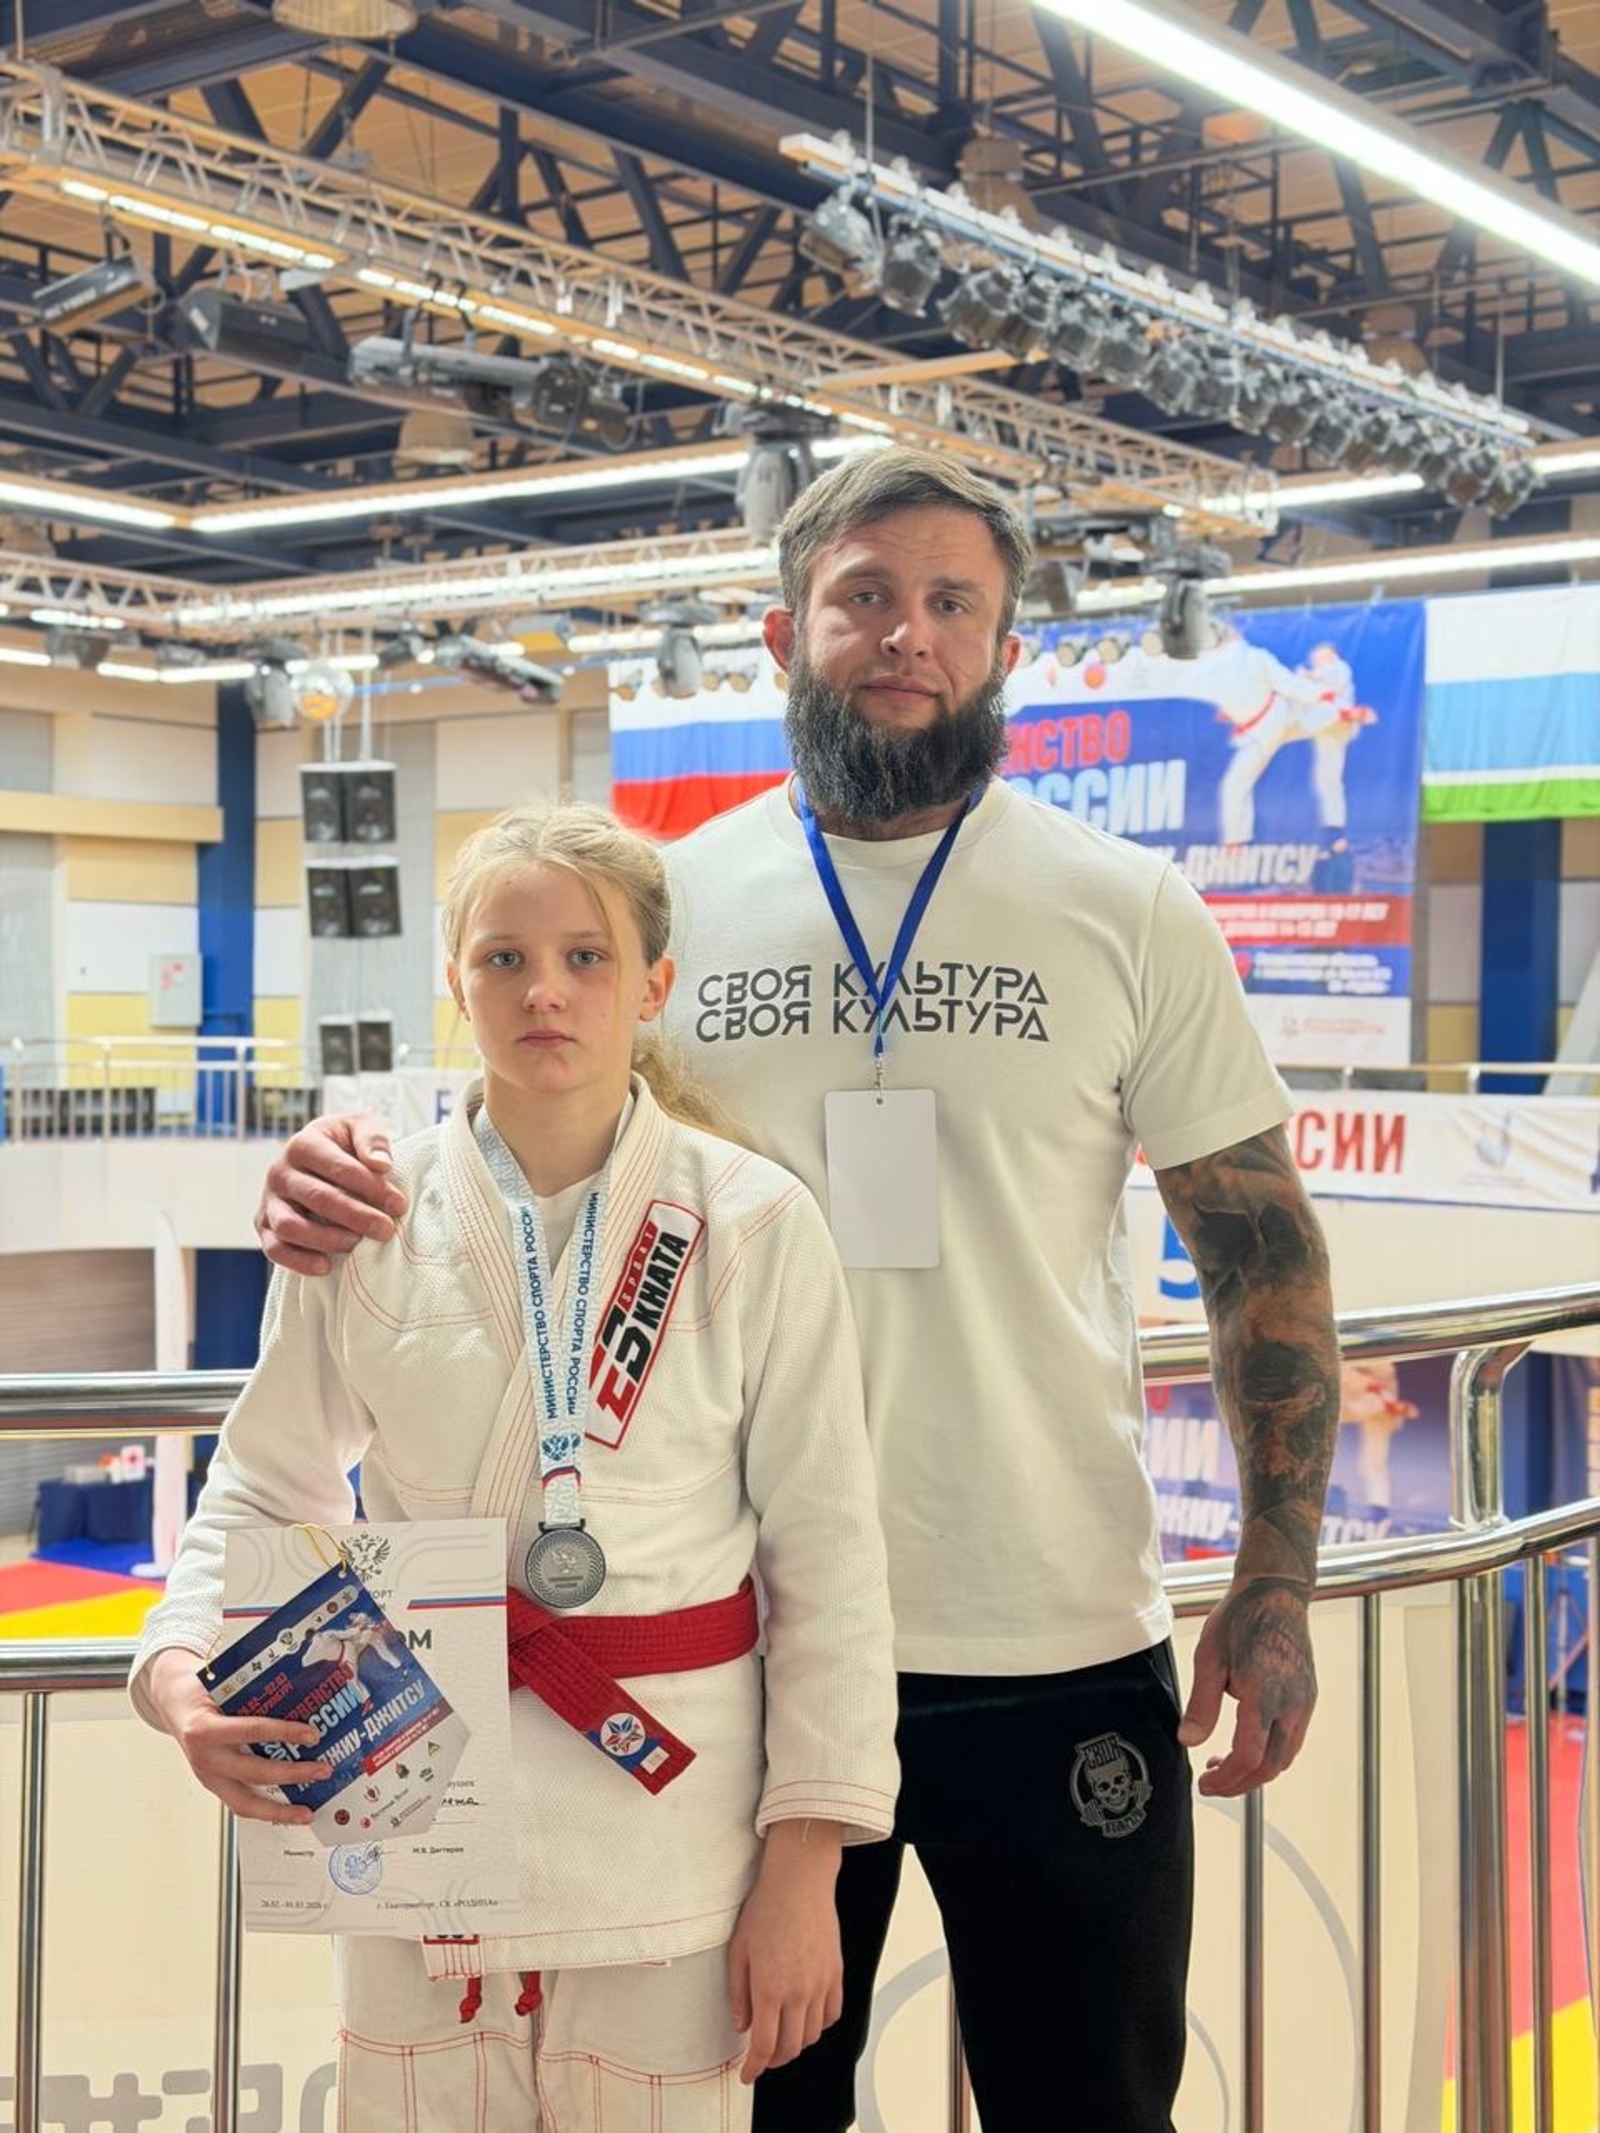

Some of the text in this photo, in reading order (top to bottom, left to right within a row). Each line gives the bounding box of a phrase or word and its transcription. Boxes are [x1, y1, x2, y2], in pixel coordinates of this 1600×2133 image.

[1003, 711, 1131, 774] НСТВО
[1008, 758, 1187, 835] ССИИ
[1152, 844, 1320, 891] -ДЖИТСУ
[698, 964, 812, 1007] СВОЯ
[695, 997, 1050, 1043] СВОЯ КУЛЬТУРА
[1295, 1109, 1405, 1174] СИИ
[578, 1192, 600, 1296] МИНИСТЕРСТВО
[527, 1256, 543, 1308] СПОРТА
[571, 1298, 588, 1353] СПОРТА
[534, 1310, 559, 1420] МИНИСТЕРСТВО
[285, 1662, 355, 1720] РВЕНСТВО
